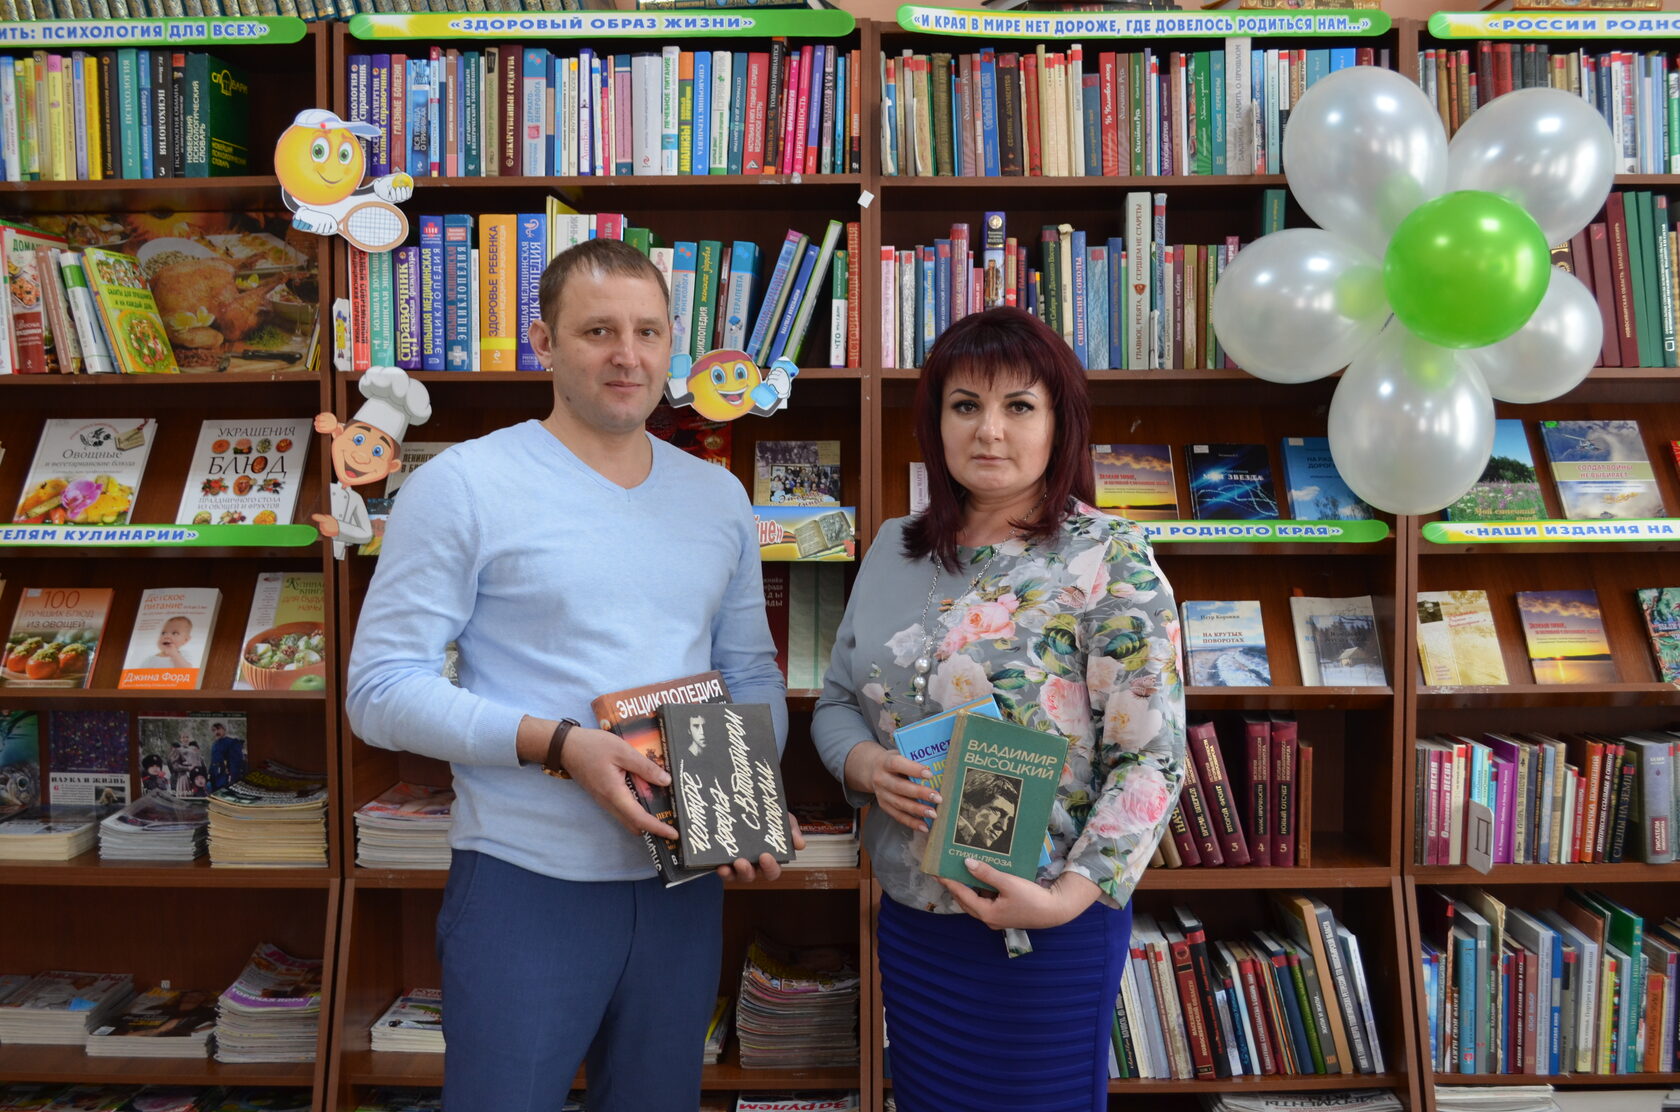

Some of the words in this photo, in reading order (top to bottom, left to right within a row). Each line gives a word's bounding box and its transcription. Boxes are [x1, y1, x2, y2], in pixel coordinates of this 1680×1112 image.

[42, 24, 162, 40] ПСИХОЛОГИЯ
[169, 24, 206, 39] ДЛЯ
[213, 23, 268, 37] ВСЕХ»
[450, 17, 583, 31] «ЗДОРОВЫЙ
[591, 17, 657, 29] ОБРАЗ
[664, 17, 753, 29] ЖИЗНИ»
[935, 15, 967, 30] КРАЯ
[971, 16, 980, 32] В
[983, 17, 1021, 33] МИРЕ
[1025, 17, 1050, 33] НЕТ
[1054, 17, 1120, 36] ДОРОЖЕ,
[1126, 17, 1151, 35] ГДЕ
[1155, 16, 1233, 33] ДОВЕЛОСЬ
[1238, 16, 1314, 33] РОДИТЬСЯ
[1488, 19, 1597, 31] «РОССИИ
[122, 59, 134, 124] ПСИХОЛОГИЯ
[394, 64, 402, 97] БОЛЕЗНИ
[506, 56, 515, 93] СРЕДСТВА
[697, 64, 705, 114] СПРАВОЧНИК
[157, 89, 167, 155] ПСИХОЛОГИЯ
[394, 100, 402, 135] ГЛАЗНЫЕ
[506, 94, 515, 158] ЛЕКАРСТВЕННЫЕ
[796, 96, 806, 159] БЕРЕМЕННОСТЬ
[199, 123, 207, 163] СЛОВАРЬ
[680, 125, 690, 172] АНАЛИЗЫ
[488, 225, 498, 274] РЕБЕНКА
[1136, 236, 1143, 246] НЕ
[371, 252, 379, 290] ДОМАШН
[381, 252, 389, 289] ЭНЦИКЛО
[421, 248, 432, 311] МЕДИЦИНСКАЯ
[446, 246, 457, 301] МЕДИЦИНСКАЯ
[521, 241, 529, 304] МЕДИЦИНСКАЯ
[529, 241, 541, 325] ЦИКЛОПЕДИЯ
[372, 292, 380, 331] БОЛЬШАЯ
[433, 248, 443, 354] ЭНЦИКЛОПЕДИЯ
[456, 246, 468, 341] ЭНЦИКЛОПЕДИЯ
[488, 279, 499, 337] ЗДОРОВЬЕ
[733, 275, 744, 314] ТЕРАПЕВТА
[422, 313, 433, 355] БОЛЬШАЯ
[447, 305, 457, 340] БОЛЬШАЯ
[521, 305, 529, 344] БОЛЬШАЯ
[696, 306, 708, 361] НЦИКЛОПЕДИЯ
[849, 310, 859, 360] ИСТОРИЯ
[1077, 300, 1085, 346] СИБИРСКИЕ
[218, 426, 296, 438] УКРАШЕНИЯ
[62, 449, 122, 459] Овощные
[208, 455, 287, 480] БЛЮД
[1227, 473, 1264, 481] ЗВЕЗДА
[64, 529, 197, 541] КУЛИНАРИИ»
[1170, 526, 1270, 536] РОДНОГО
[1278, 526, 1341, 536] КРАЯ»
[1465, 526, 1538, 537] «НАШИ
[1546, 525, 1640, 536] ИЗДАНИЯ
[1649, 524, 1674, 534] НА
[43, 590, 81, 609] 100
[124, 672, 159, 684] Джина
[161, 671, 191, 684] Форд
[615, 679, 723, 719] ЭНЦИКЛОПЕДИЯ
[964, 752, 1055, 781] ВЫСОЦКИЙ
[967, 739, 1058, 767] ВЛАДИМИР
[1587, 755, 1599, 802] ПОКОЛЕНИЙ
[1621, 774, 1633, 802] ЗЕМЛ
[1585, 803, 1595, 853] ПЕРЕКЛИЧКА
[1620, 804, 1628, 818] НА
[1205, 842, 1214, 852] 2
[1257, 842, 1265, 852] 4
[1280, 843, 1287, 853] 5
[1613, 820, 1626, 858] СЛЕДЫ
